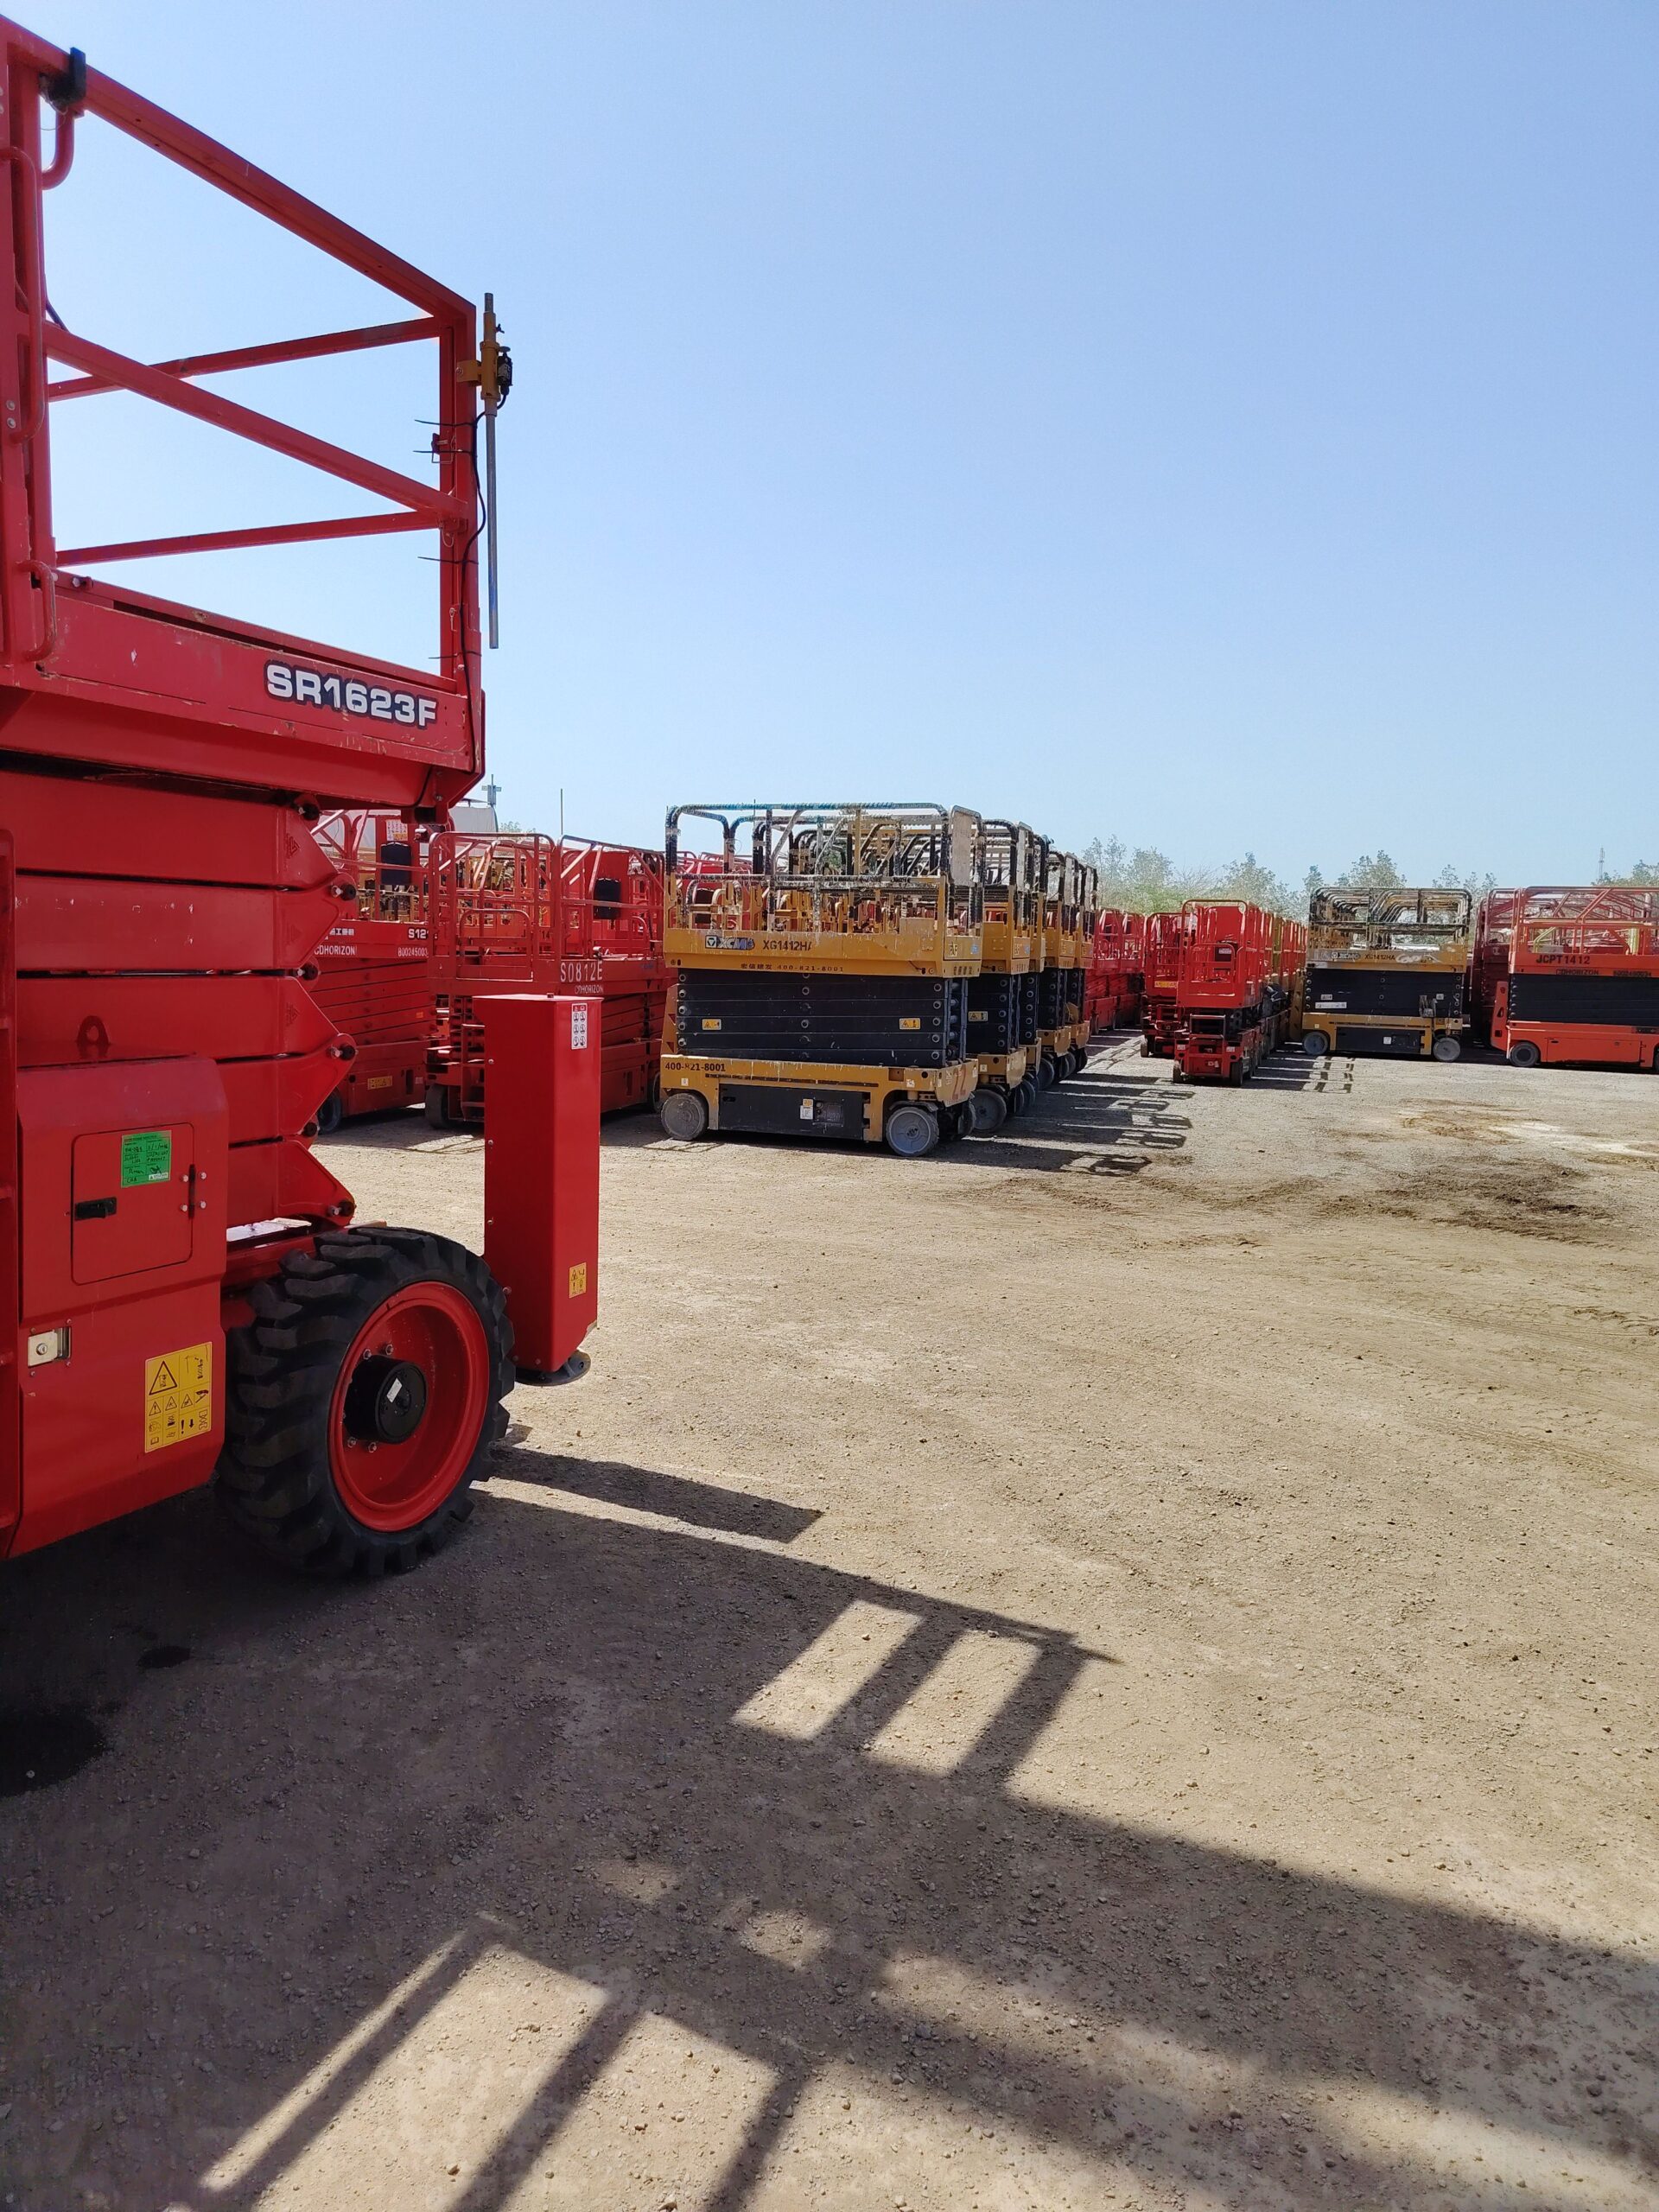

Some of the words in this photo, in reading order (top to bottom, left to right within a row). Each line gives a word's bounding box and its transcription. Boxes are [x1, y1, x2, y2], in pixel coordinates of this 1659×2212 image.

[266, 664, 436, 727] SR1623F
[1535, 954, 1591, 965] JCPT1412
[560, 960, 603, 982] S0812E
